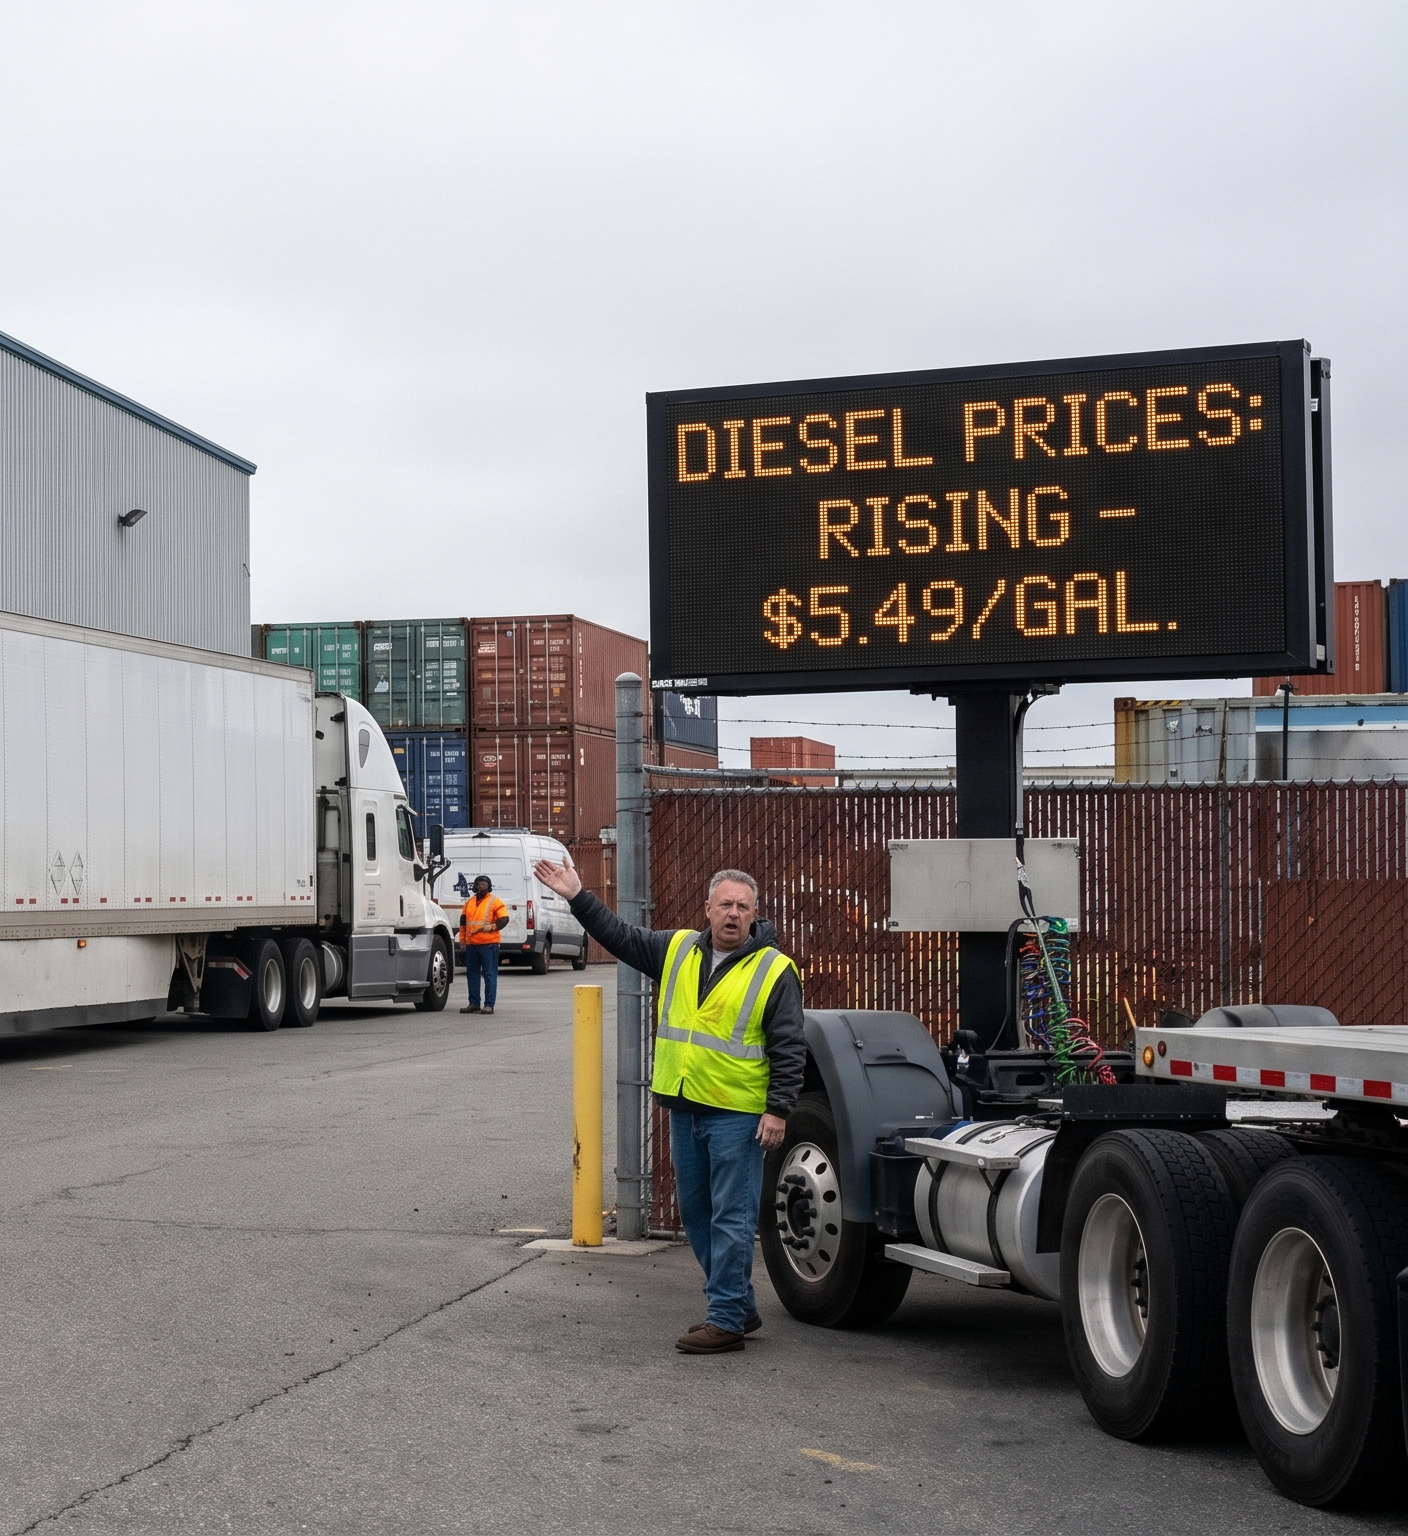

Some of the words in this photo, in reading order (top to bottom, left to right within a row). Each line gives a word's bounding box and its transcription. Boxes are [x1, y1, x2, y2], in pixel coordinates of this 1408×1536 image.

[678, 409, 933, 482] DIESEL
[965, 384, 1261, 461] PRICES:
[820, 486, 1069, 559] RISING
[764, 572, 1176, 648] $5.49/GAL.
